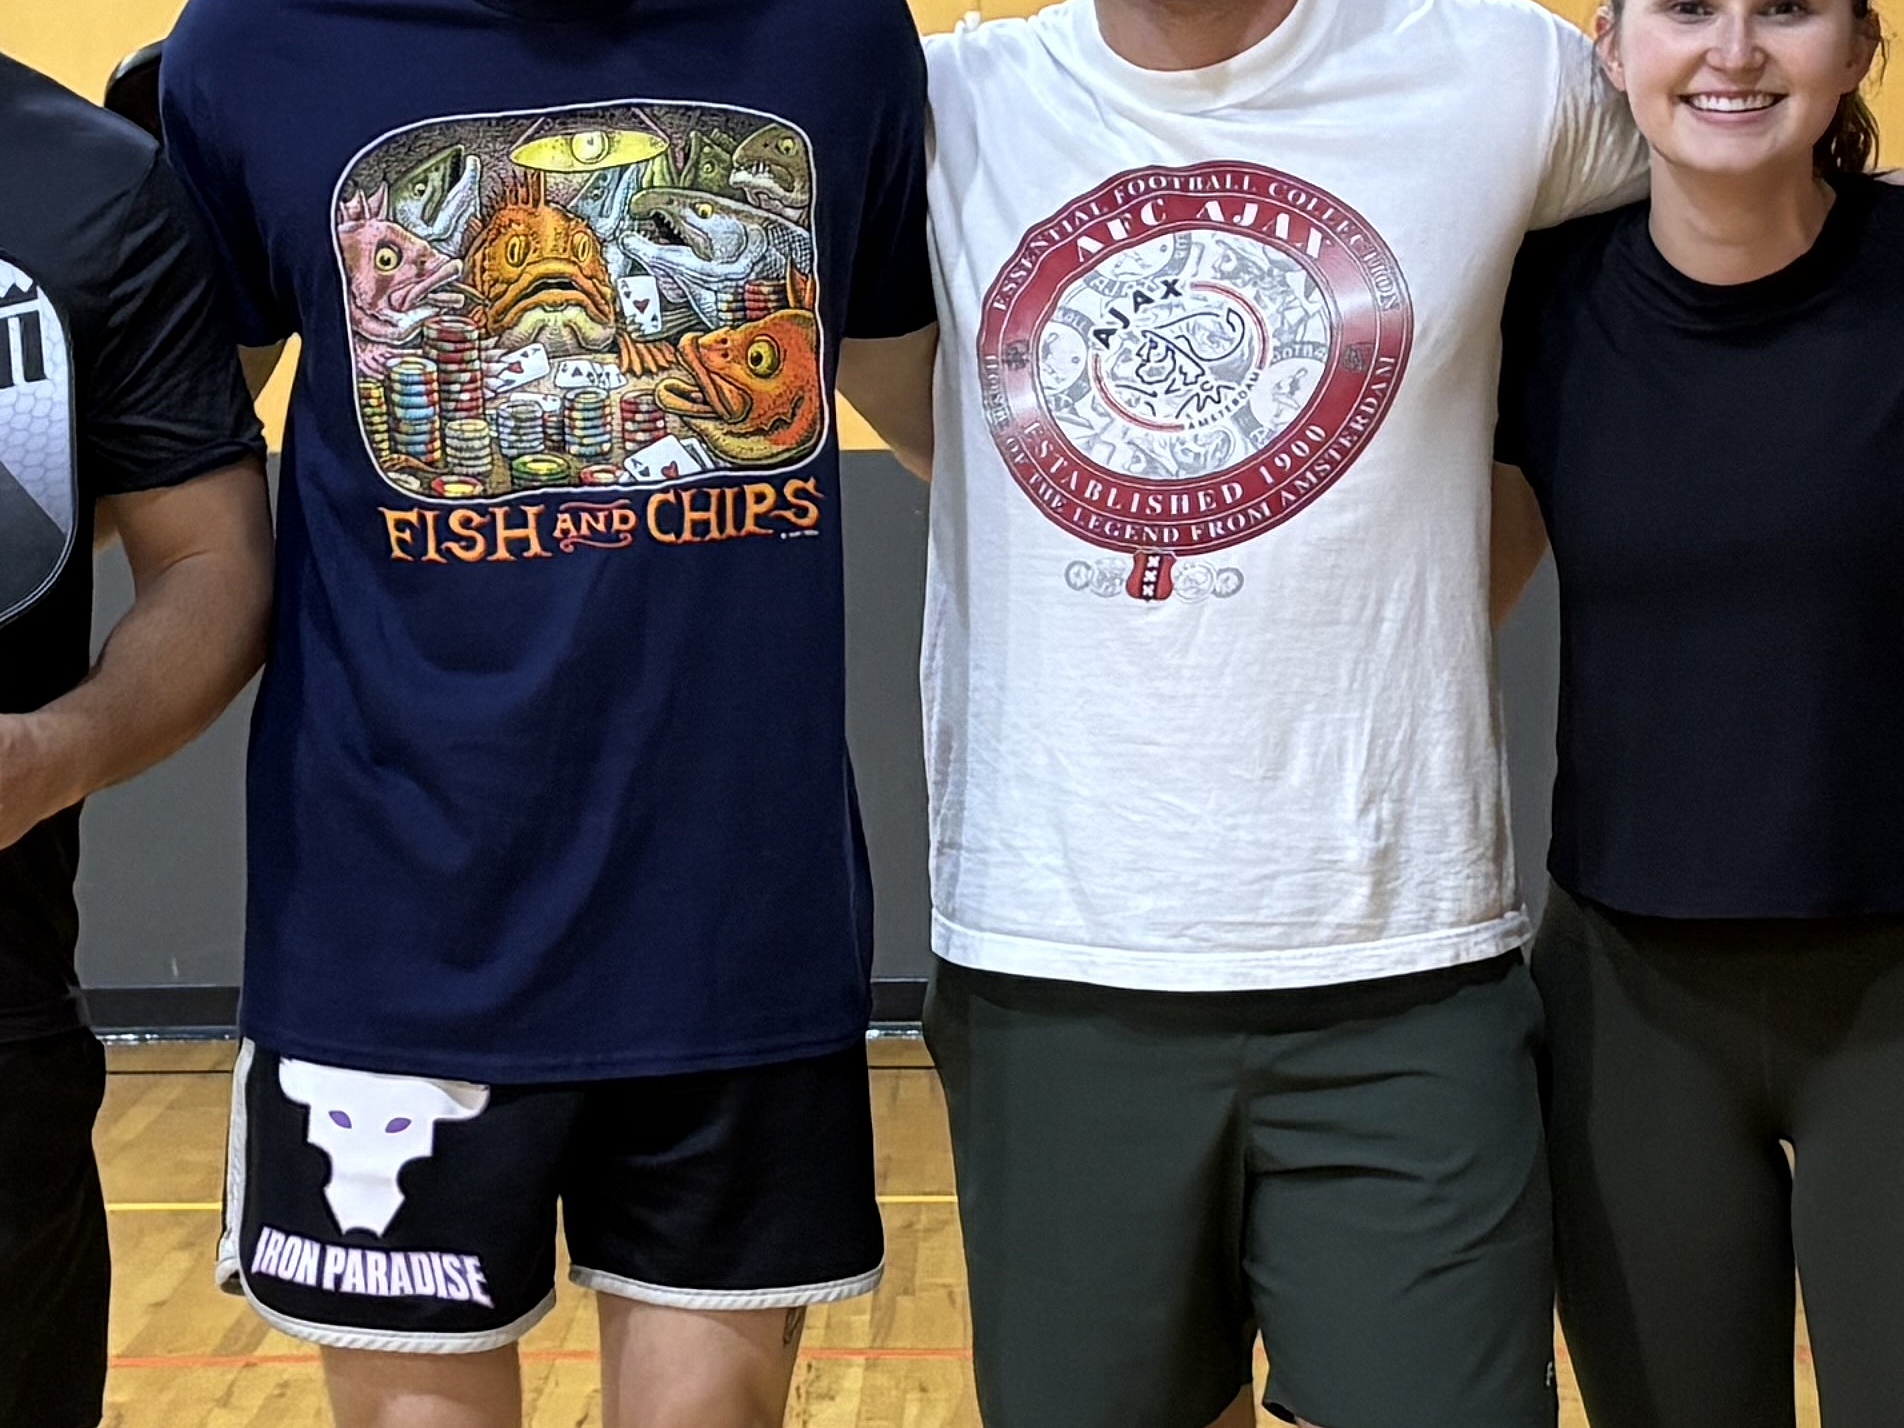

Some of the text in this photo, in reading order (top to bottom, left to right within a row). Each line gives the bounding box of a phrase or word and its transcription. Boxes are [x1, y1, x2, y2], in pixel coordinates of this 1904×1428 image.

[993, 174, 1400, 311] ESSENTIAL FOOTBALL COLLECTION
[1077, 198, 1331, 262] AFC AJAX
[1093, 278, 1183, 350] AJAX
[1023, 422, 1326, 515] ESTABLISHED 1900
[1029, 471, 1066, 509] THE
[1072, 507, 1180, 544] LEGEND
[1190, 501, 1272, 541] FROM
[1280, 357, 1396, 507] AMSTERDAM
[378, 477, 825, 563] FISH AND CHIPS
[251, 1226, 495, 1309] IRON PARADISE
